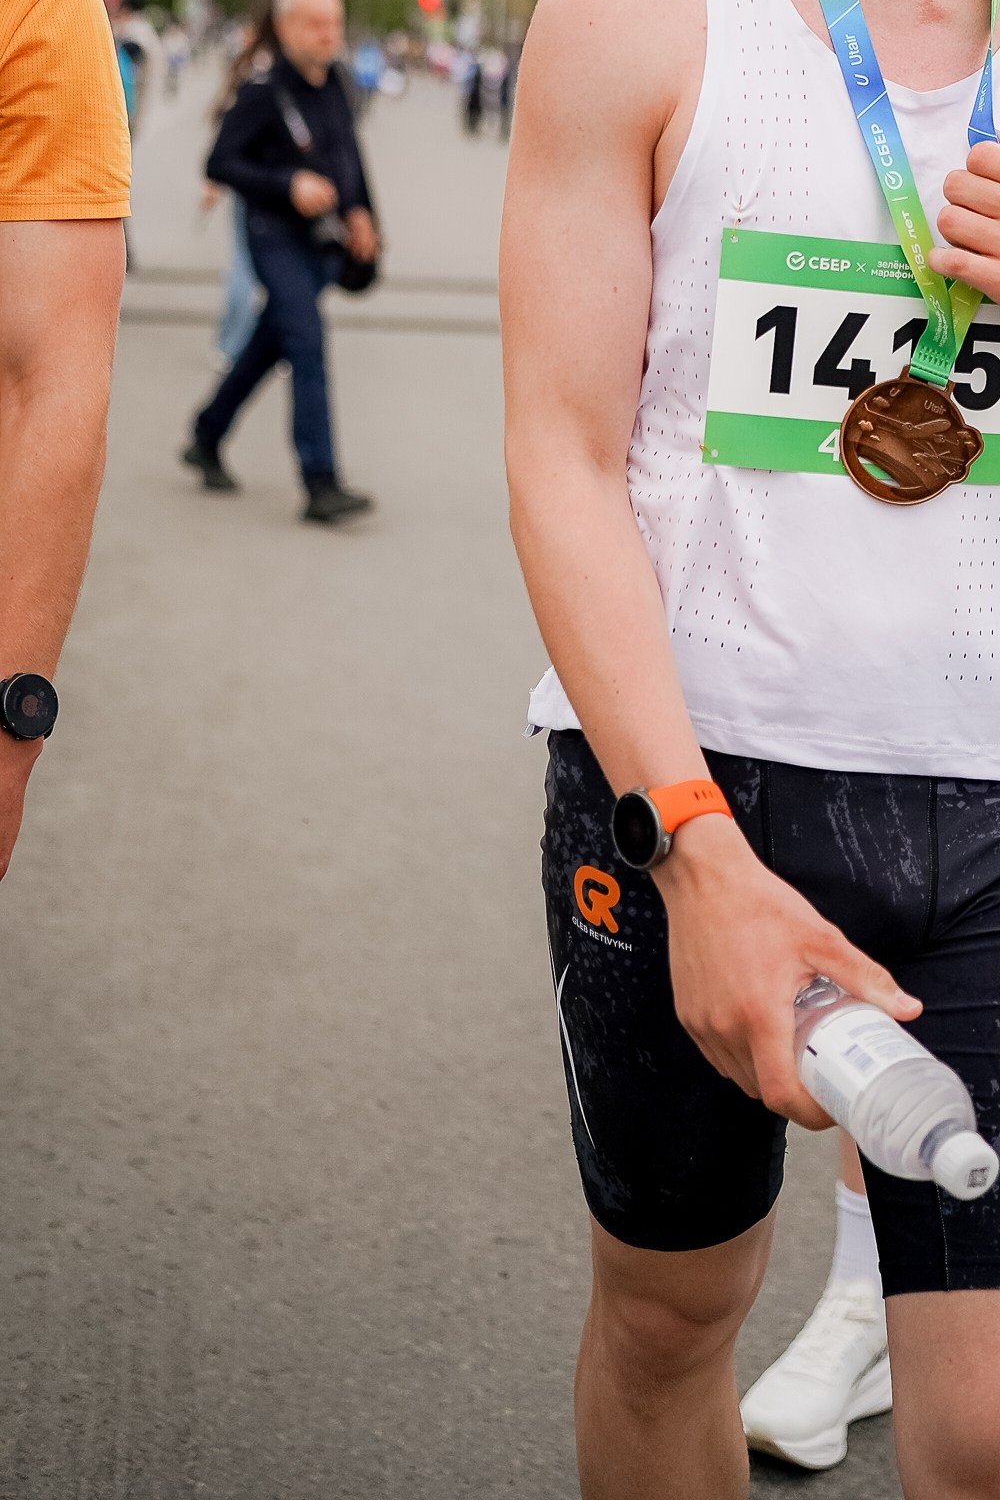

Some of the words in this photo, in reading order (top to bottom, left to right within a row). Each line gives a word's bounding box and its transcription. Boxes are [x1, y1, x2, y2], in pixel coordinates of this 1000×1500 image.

[844, 34, 863, 66] Utair
[871, 123, 893, 167] СБЕР
[902, 210, 917, 239] лет
[808, 256, 851, 272] СБЕР
[877, 259, 912, 271] зелёны
[911, 243, 926, 273] 185
[870, 269, 914, 280] марафон
[923, 399, 949, 416] Utair
[571, 916, 589, 934] GLEB
[589, 928, 633, 952] RETIVYKH
